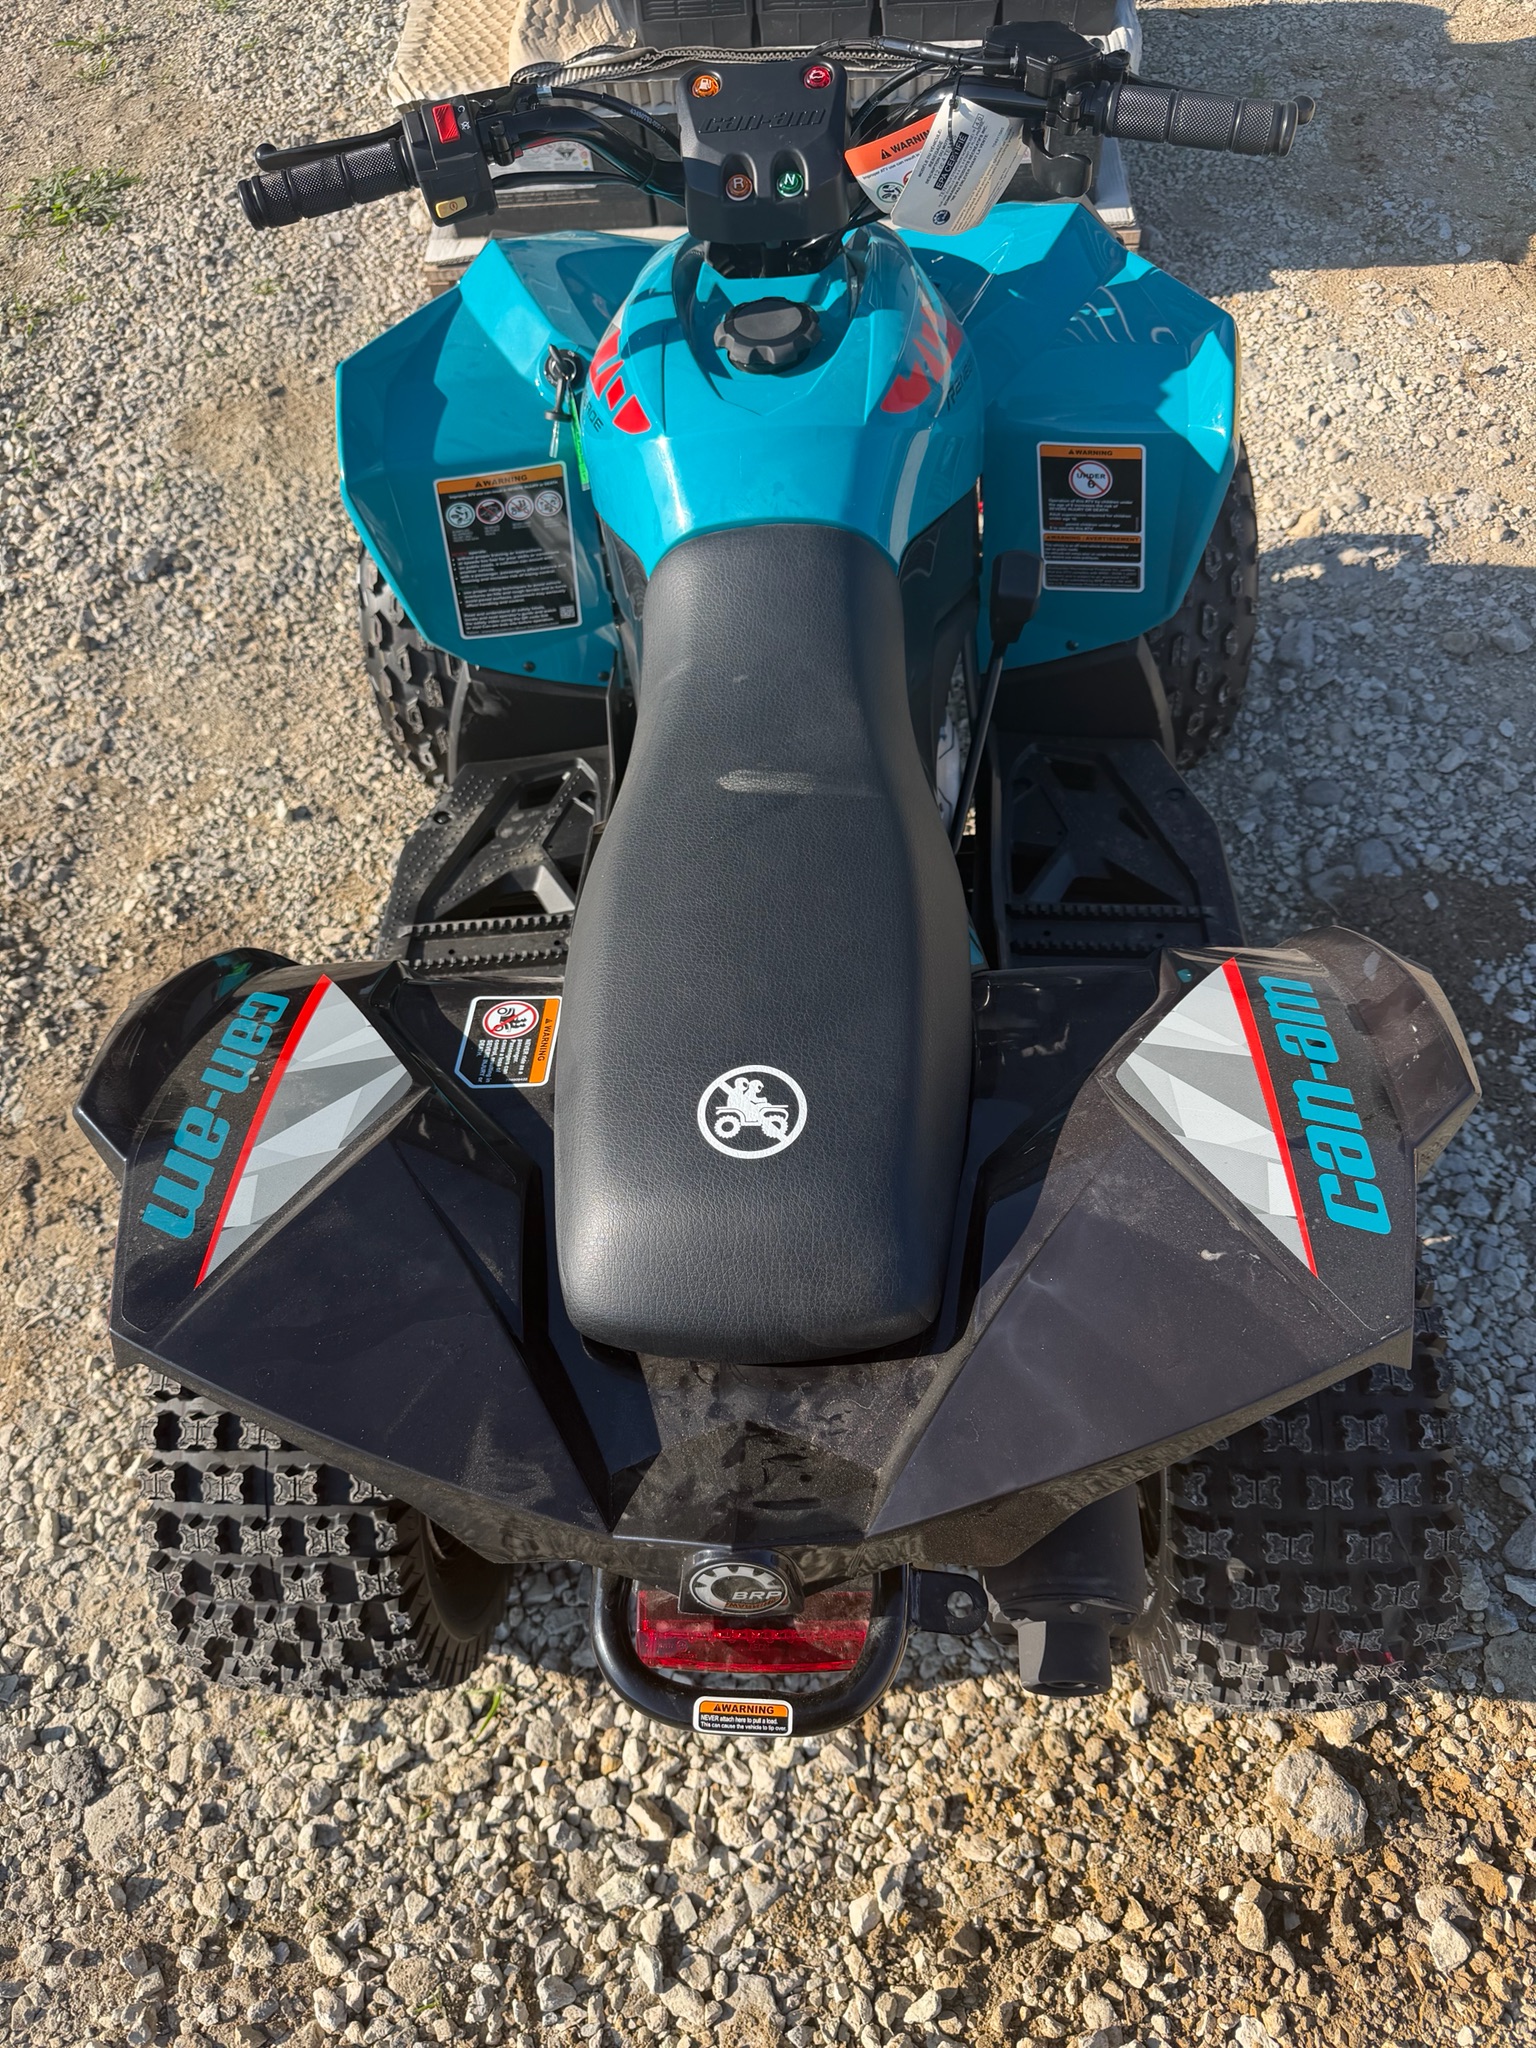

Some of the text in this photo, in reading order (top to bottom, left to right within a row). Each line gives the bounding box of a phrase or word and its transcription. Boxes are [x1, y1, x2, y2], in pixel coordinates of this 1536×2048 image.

[699, 108, 826, 133] can-am
[889, 129, 931, 154] WARNIN
[927, 140, 943, 167] RENEGADE
[733, 177, 744, 189] R
[783, 173, 796, 185] N
[932, 169, 940, 179] 112
[935, 171, 948, 188] EPA
[483, 474, 528, 486] WARNING
[483, 1039, 493, 1058] SEVERE
[504, 1038, 516, 1065] Passengers
[512, 1038, 523, 1063] passenger.
[522, 1038, 531, 1054] NEVER
[537, 1025, 552, 1062] WARNING
[1258, 975, 1392, 1235] can-am
[142, 991, 290, 1239] can-am
[731, 1591, 783, 1600] BRP
[721, 1704, 774, 1714] WARNING
[752, 1717, 761, 1725] pull
